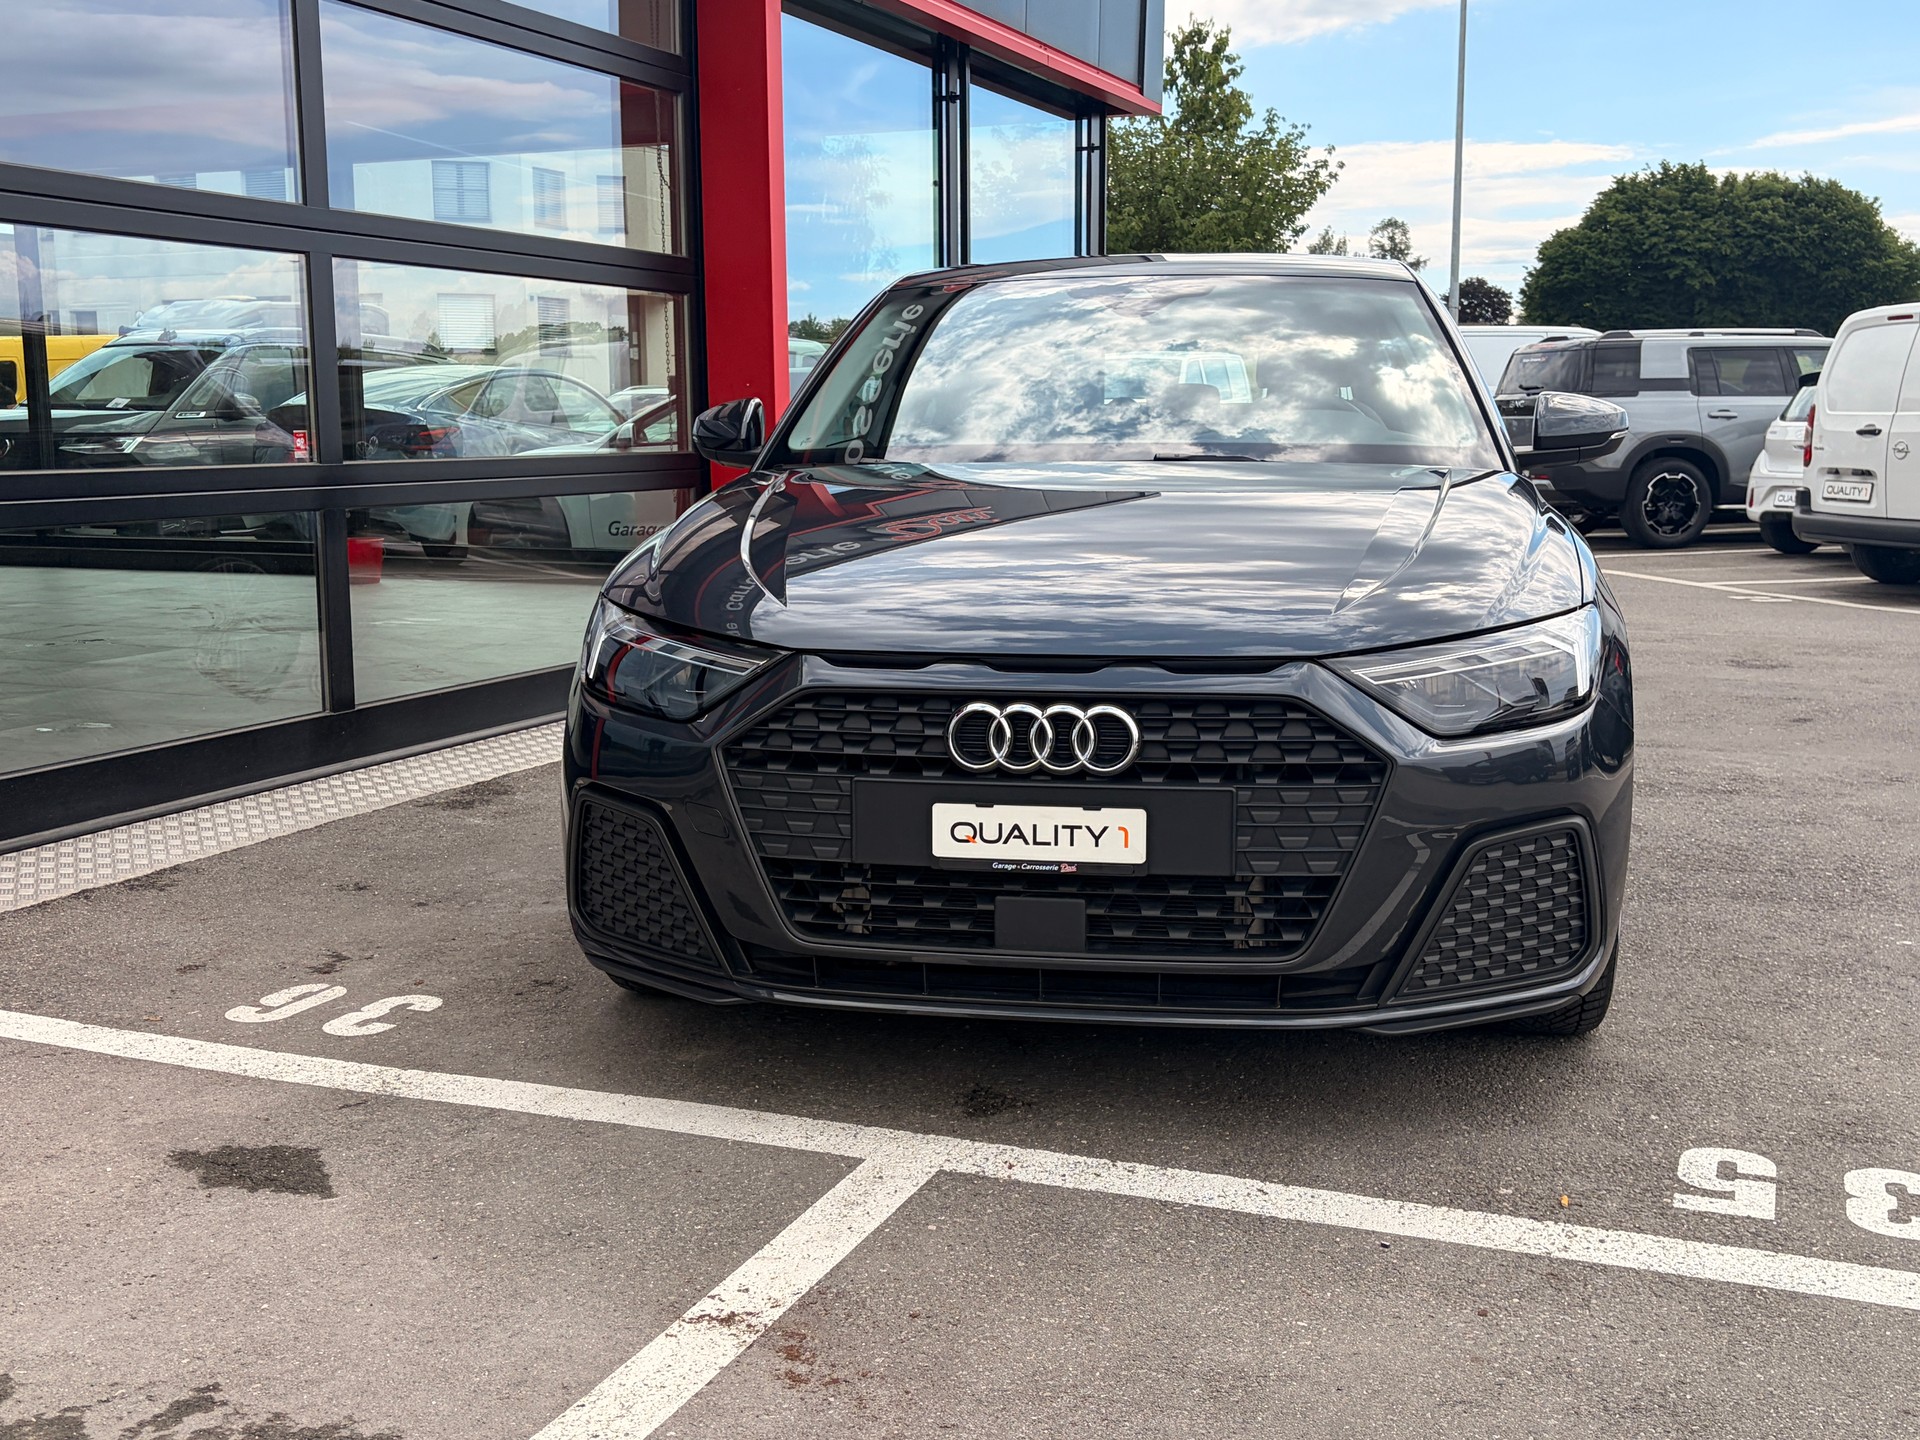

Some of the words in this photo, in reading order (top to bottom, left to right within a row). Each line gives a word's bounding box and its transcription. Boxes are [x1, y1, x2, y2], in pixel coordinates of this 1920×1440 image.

[1826, 485, 1863, 497] QUALITY
[950, 821, 1109, 848] QUALITY
[1118, 826, 1129, 849] 1
[992, 861, 1017, 871] Garage
[1021, 862, 1059, 871] Carrosserie
